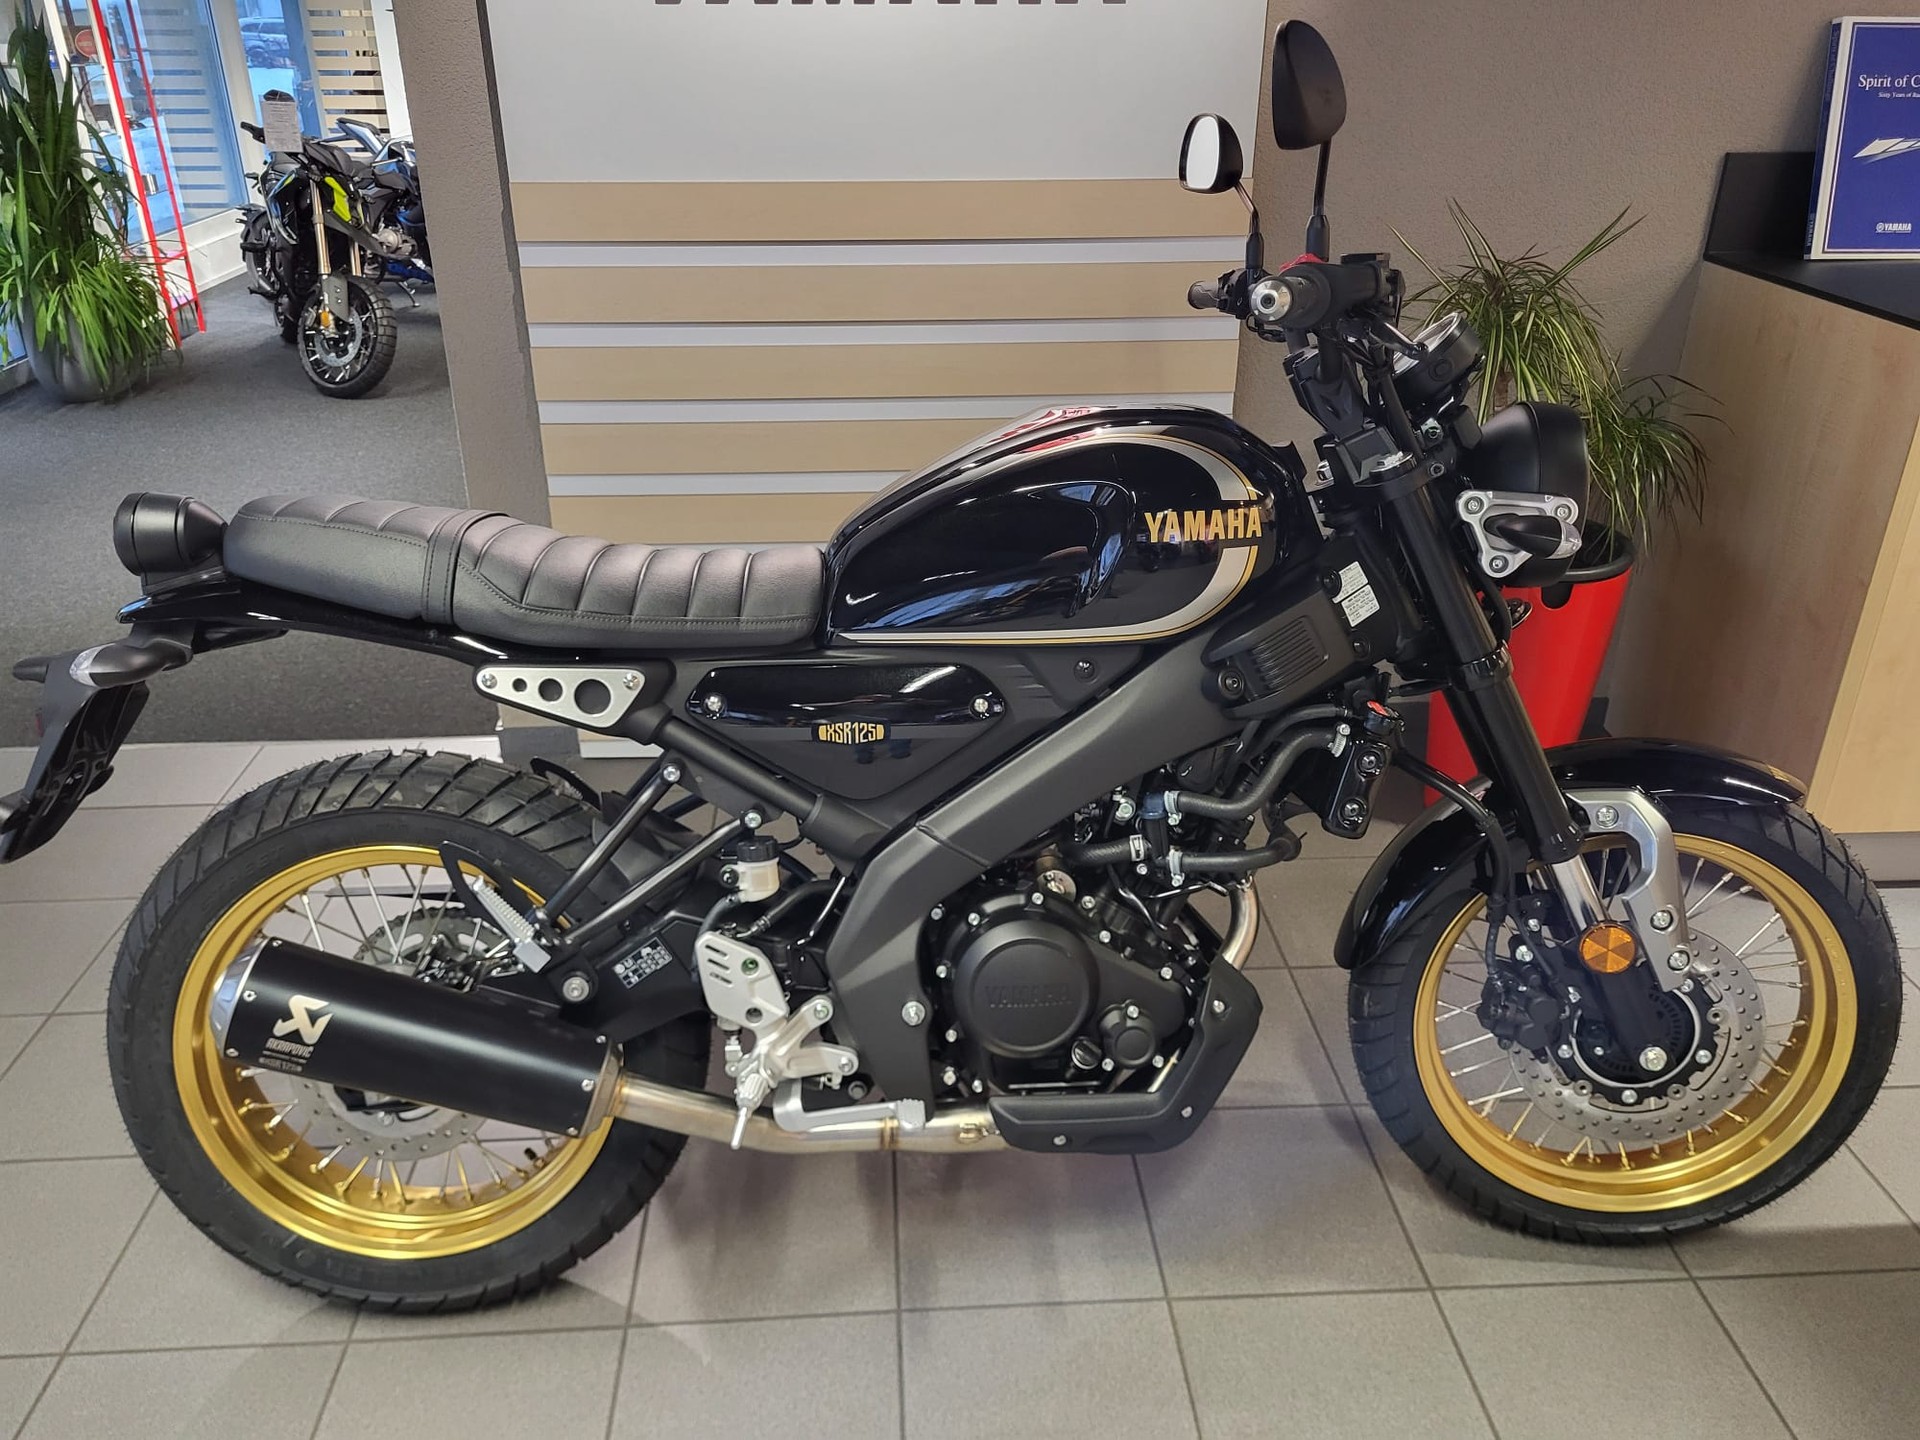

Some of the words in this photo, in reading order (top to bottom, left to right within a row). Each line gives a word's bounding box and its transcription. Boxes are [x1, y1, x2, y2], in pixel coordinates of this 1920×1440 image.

[1858, 74, 1891, 90] Spirit
[1894, 74, 1909, 87] of
[1885, 223, 1911, 231] YAMAHA
[1144, 507, 1262, 543] YAMAHA
[827, 722, 876, 745] XSR125
[985, 984, 1072, 1009] YAMAHA
